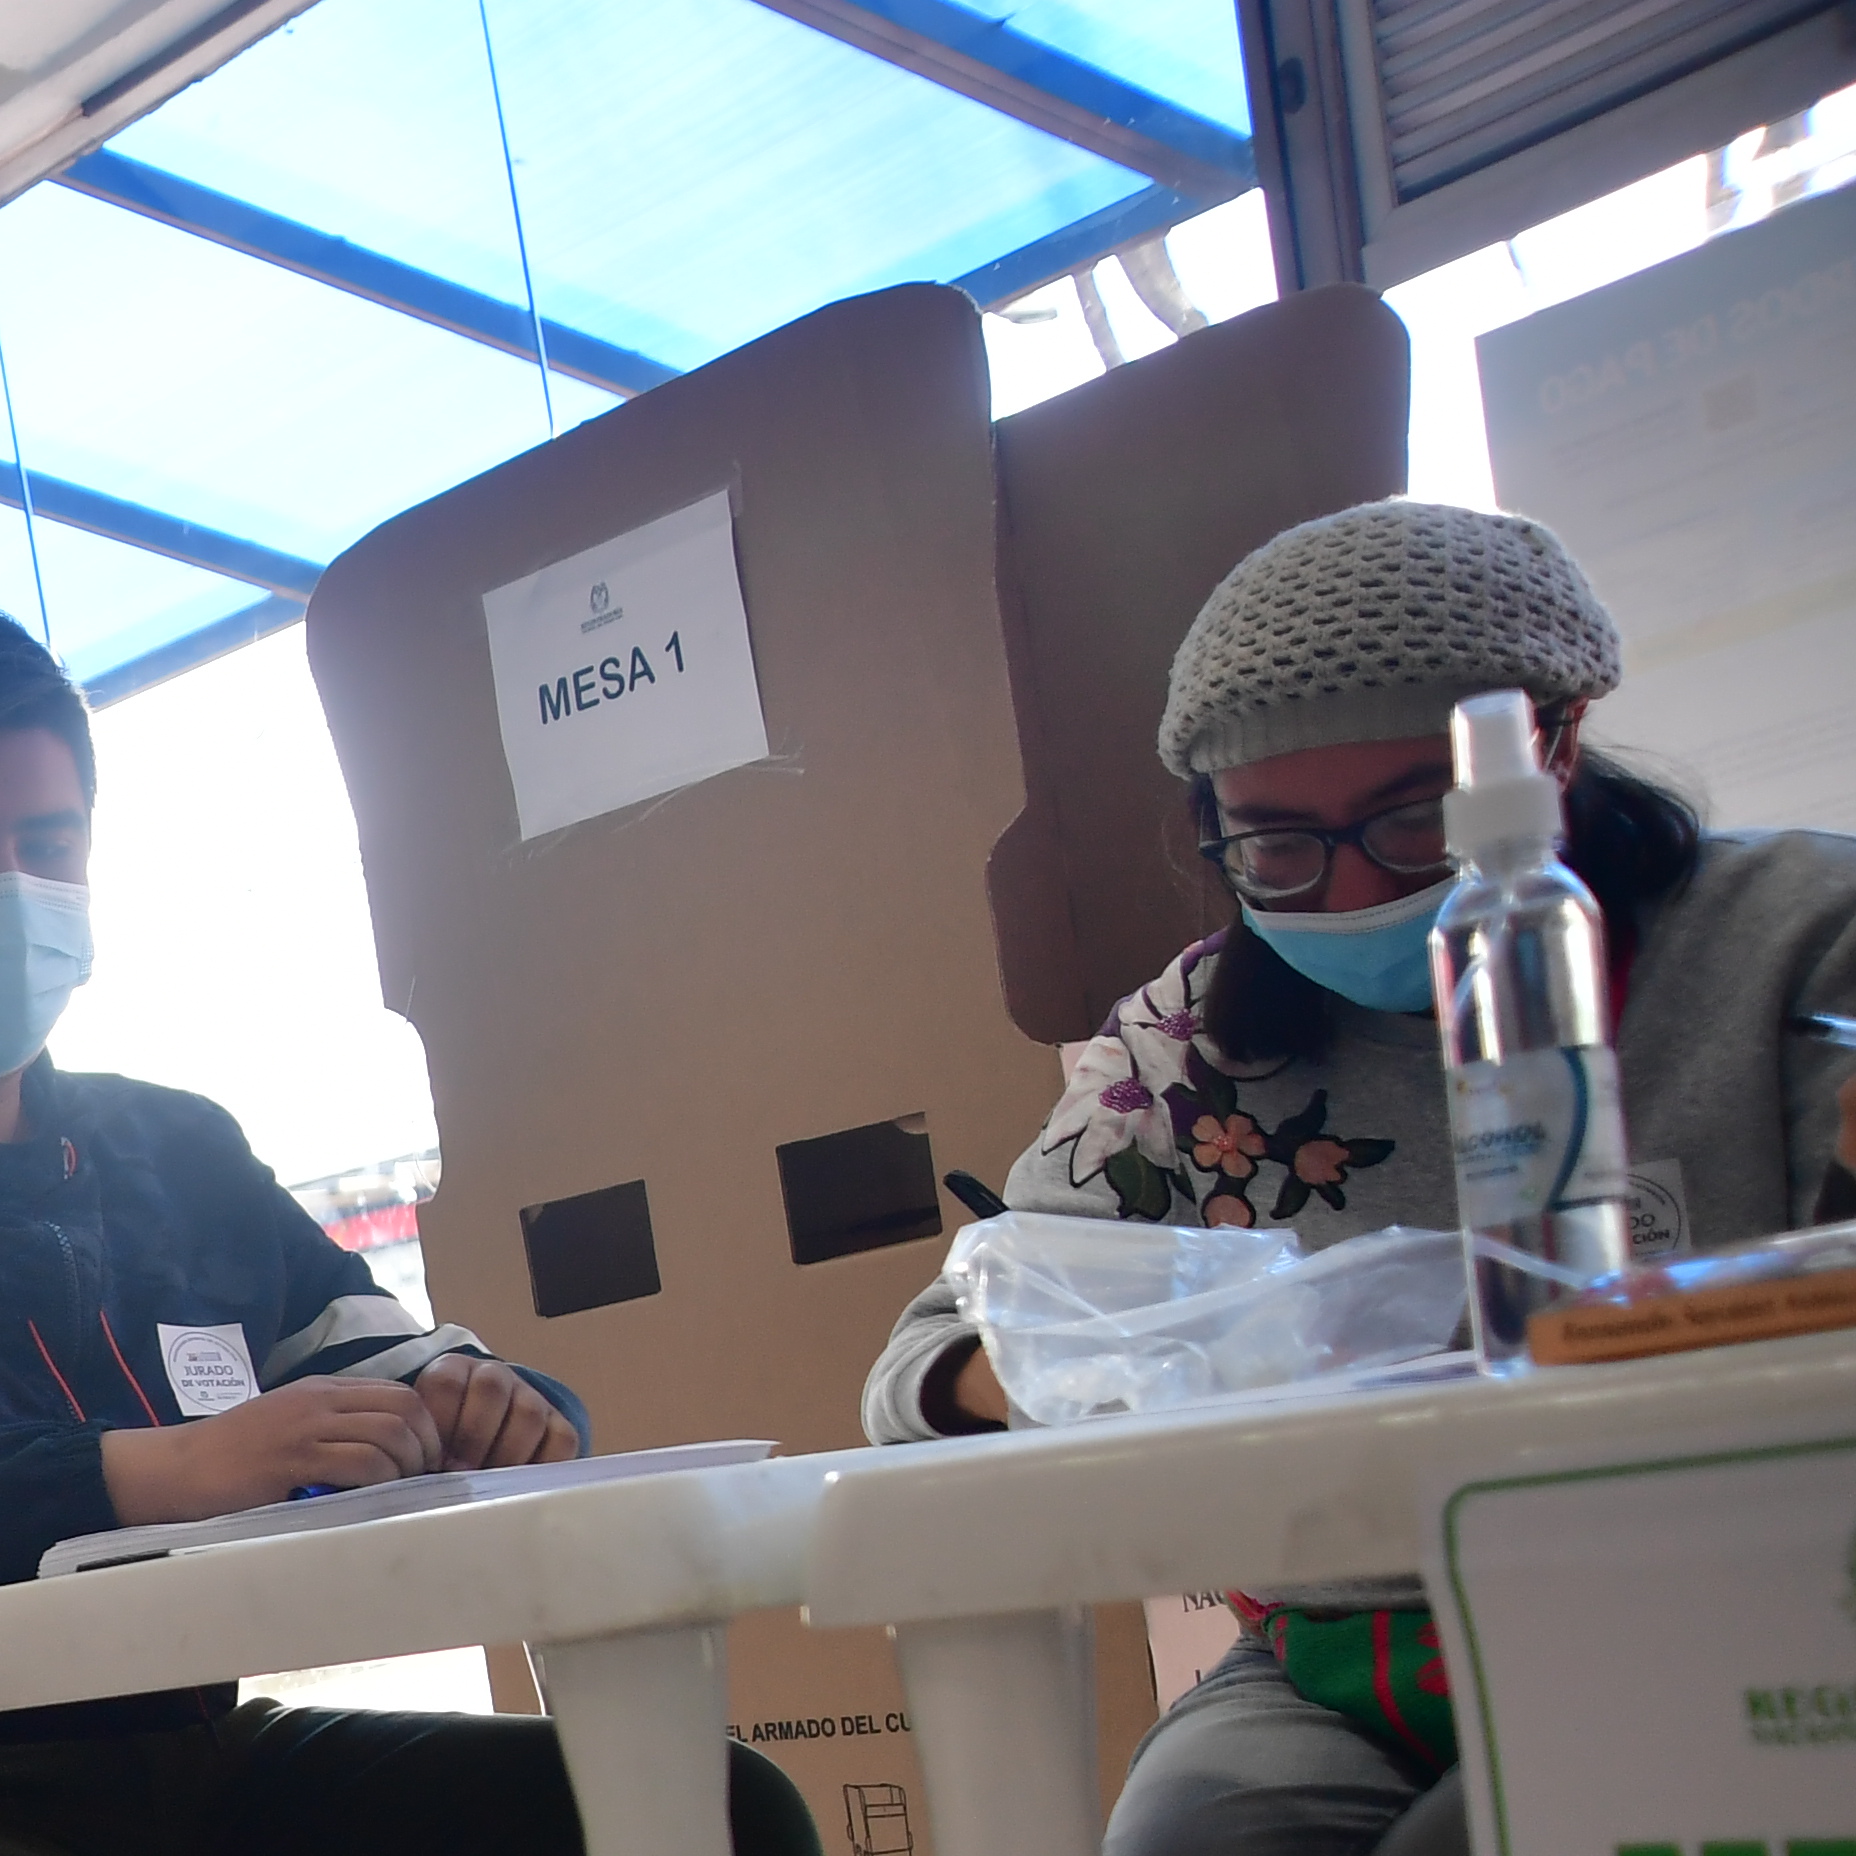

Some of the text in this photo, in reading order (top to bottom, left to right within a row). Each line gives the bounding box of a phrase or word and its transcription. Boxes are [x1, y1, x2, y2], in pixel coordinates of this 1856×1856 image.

[538, 630, 685, 725] MESA 1
[184, 1365, 234, 1376] JURADO
[181, 1377, 245, 1387] DE VOTACIÓN
[751, 1717, 836, 1743] ARMADO
[840, 1714, 882, 1737] DEL
